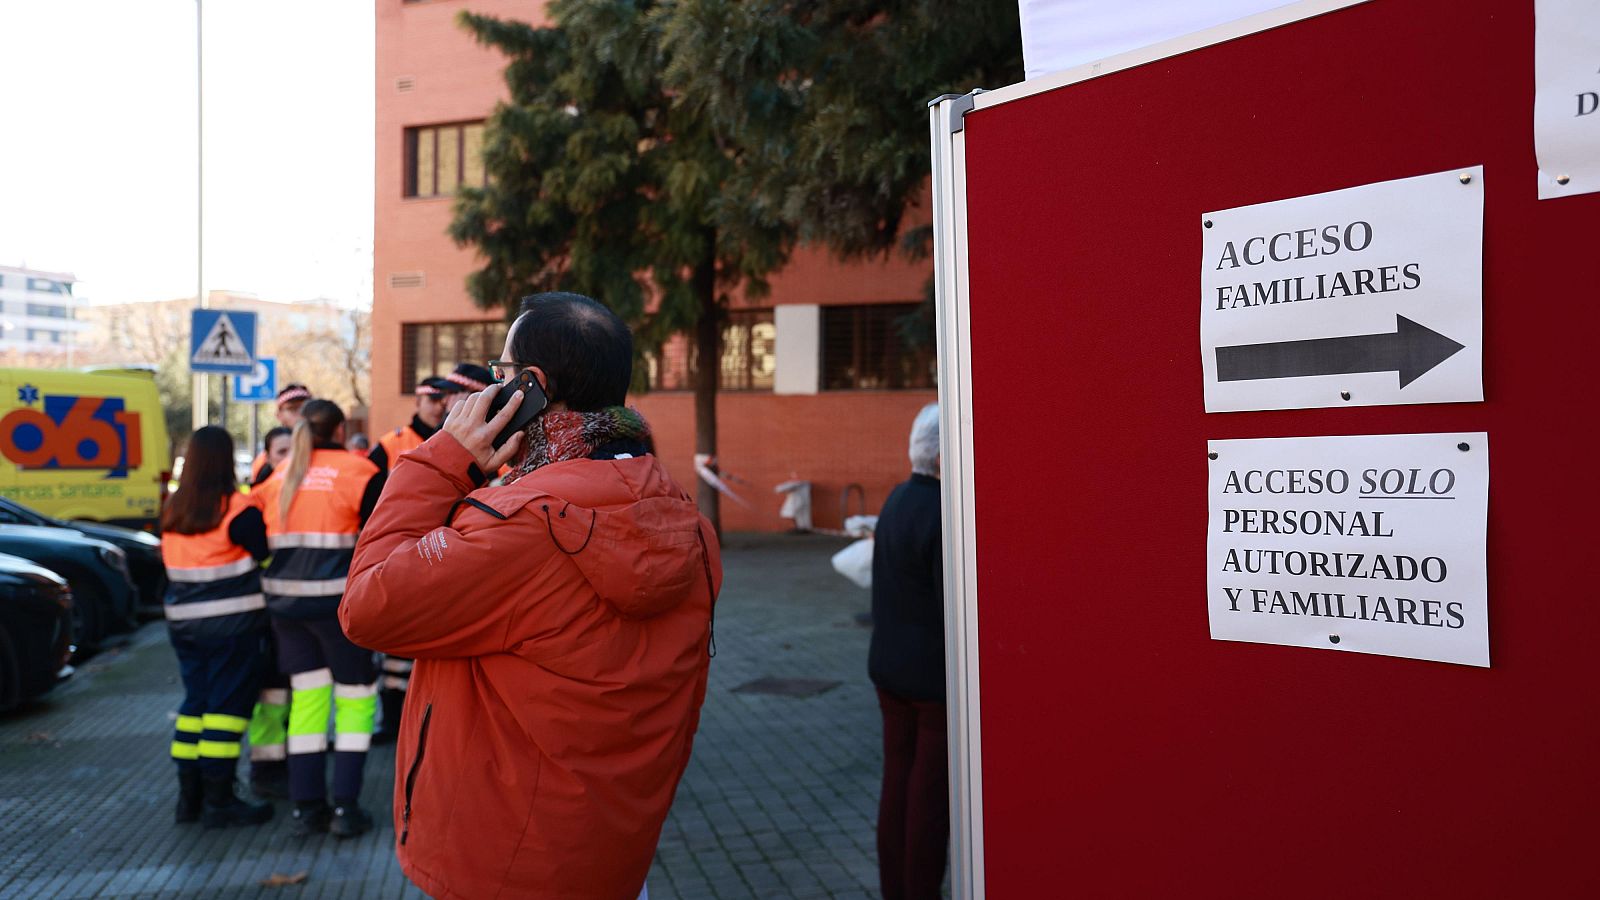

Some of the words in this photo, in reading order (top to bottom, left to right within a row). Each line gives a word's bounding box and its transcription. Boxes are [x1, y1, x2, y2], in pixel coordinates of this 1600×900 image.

[1215, 220, 1373, 271] ACCESO
[1215, 262, 1421, 311] FAMILIARES
[0, 395, 143, 469] 061
[1222, 469, 1350, 494] ACCESO
[1359, 468, 1456, 499] SOLO
[1222, 509, 1394, 538] PERSONAL
[1221, 548, 1448, 584] AUTORIZADO
[1222, 587, 1244, 612] Y
[1249, 588, 1465, 630] FAMILIARES
